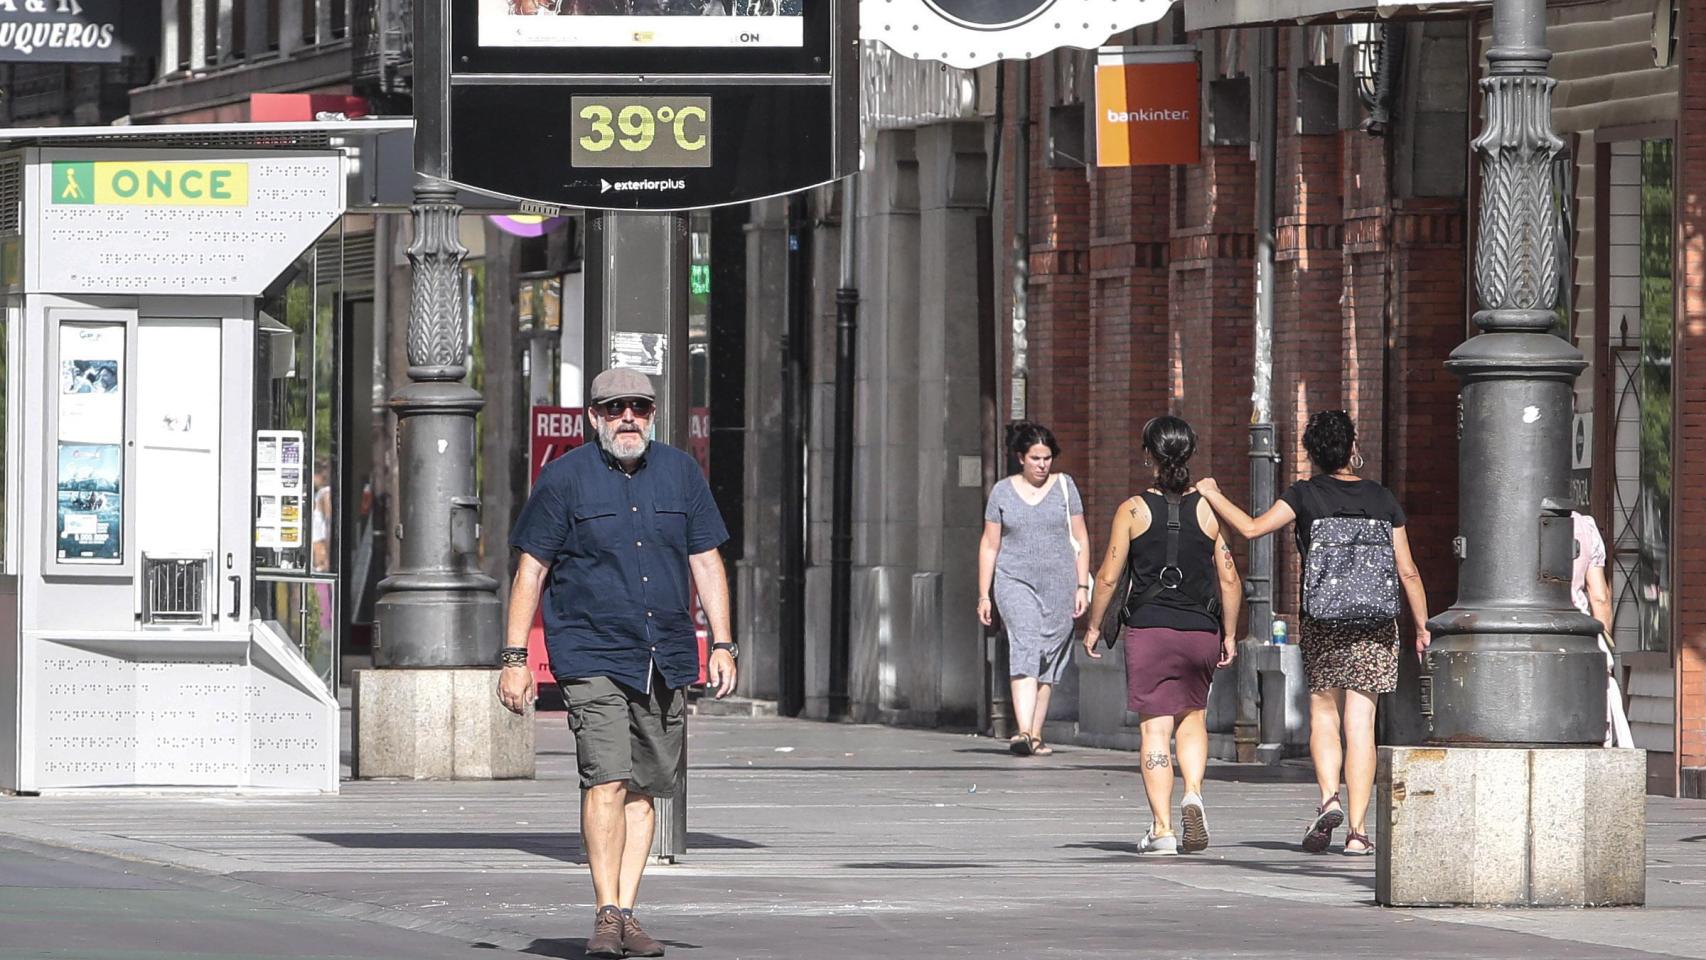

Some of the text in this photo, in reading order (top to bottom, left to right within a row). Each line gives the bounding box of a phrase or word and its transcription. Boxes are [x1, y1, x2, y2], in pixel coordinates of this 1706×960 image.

[579, 105, 706, 152] 39°C
[111, 169, 232, 199] ONCE
[614, 178, 686, 192] exteriorplus
